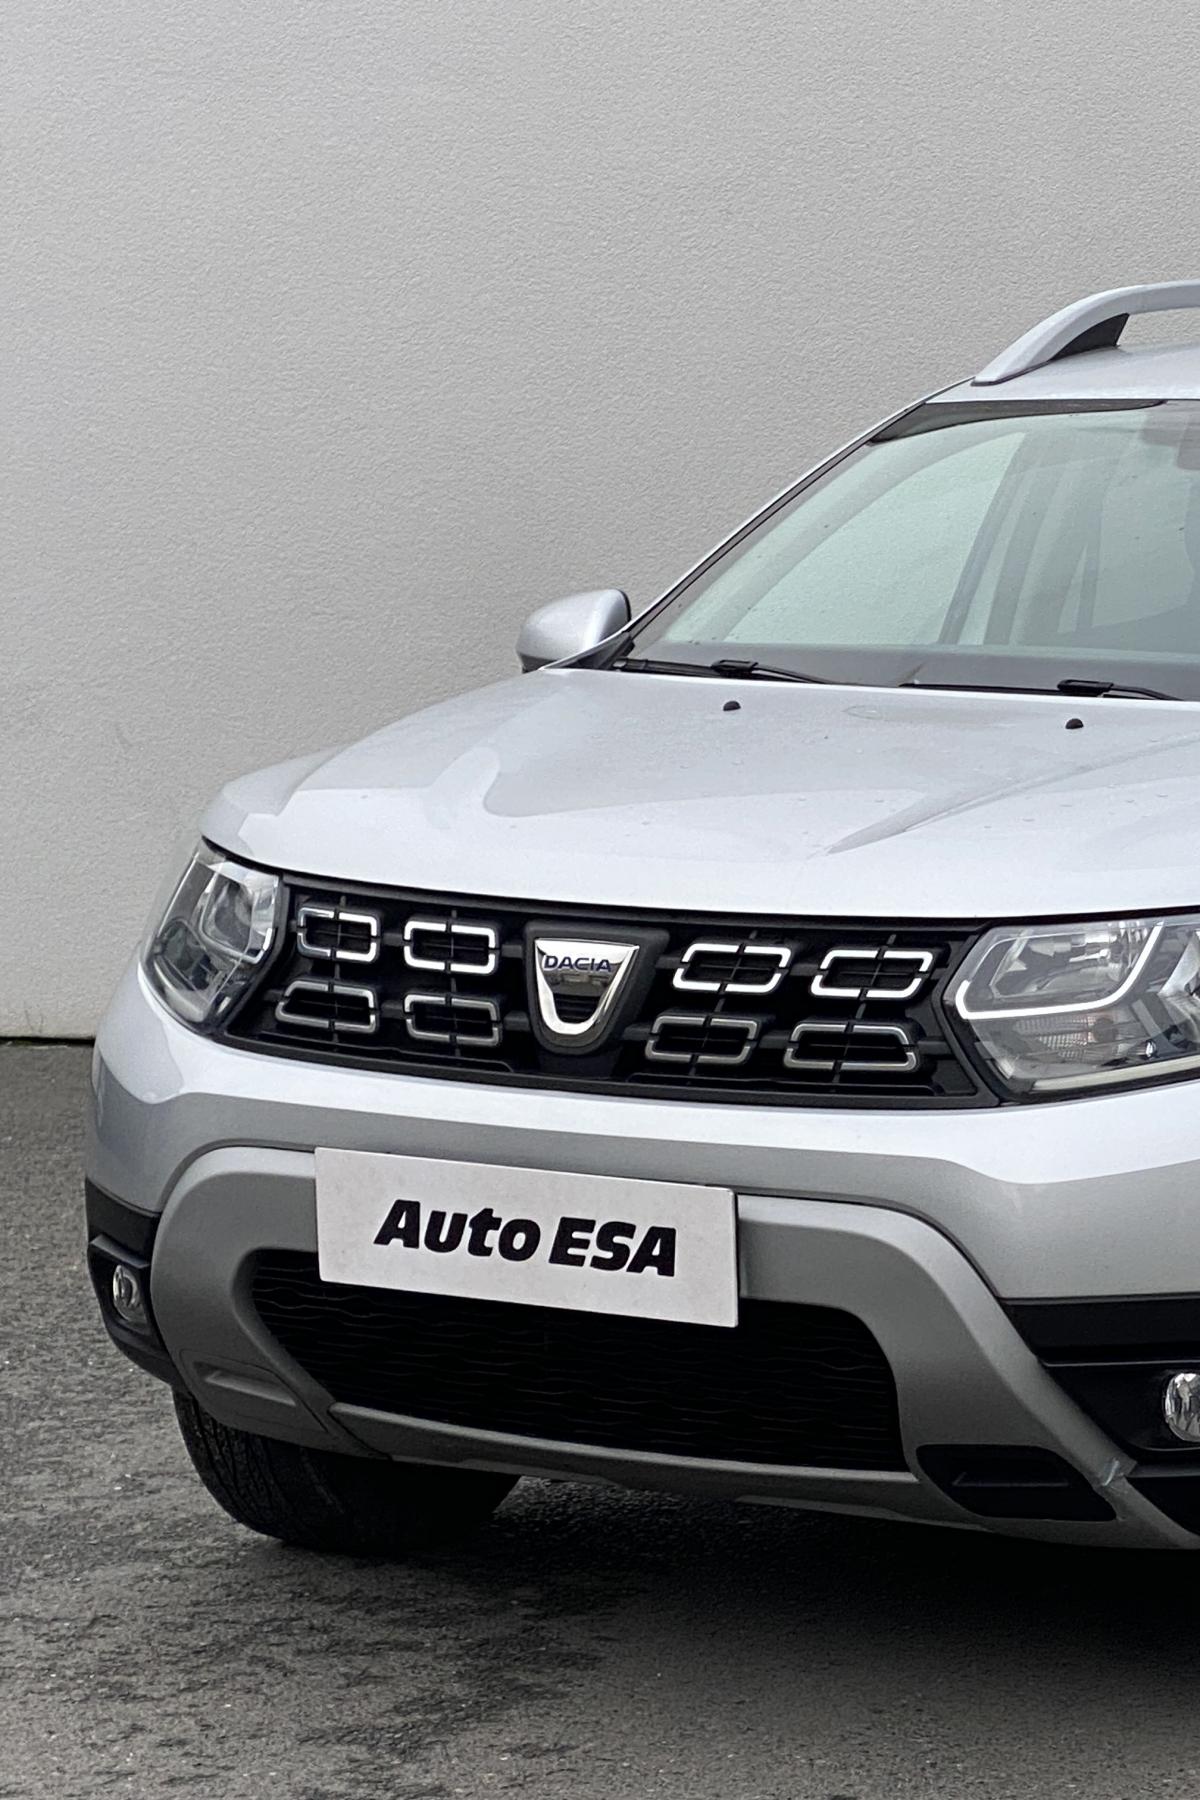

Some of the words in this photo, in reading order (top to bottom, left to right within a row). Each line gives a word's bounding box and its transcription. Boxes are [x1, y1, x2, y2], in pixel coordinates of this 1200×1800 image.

[543, 955, 612, 973] DACIA
[373, 1199, 541, 1262] Auto
[548, 1216, 677, 1278] ESA
